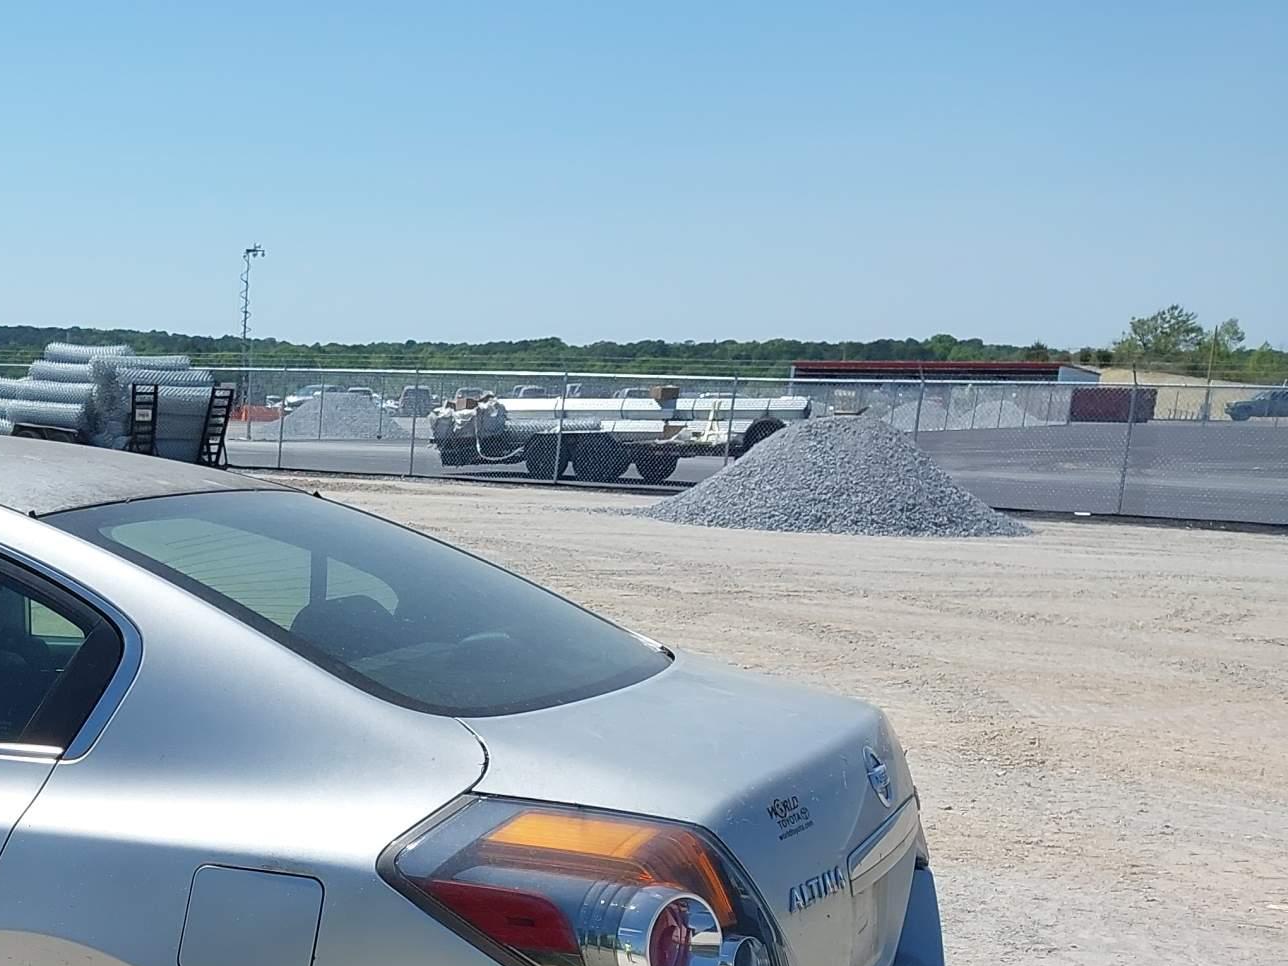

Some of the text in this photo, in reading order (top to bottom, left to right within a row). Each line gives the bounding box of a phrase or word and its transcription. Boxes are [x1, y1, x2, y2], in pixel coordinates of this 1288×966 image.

[766, 796, 799, 819] WORLD
[777, 813, 803, 829] TOYOTA
[788, 865, 847, 914] ALTIMA
